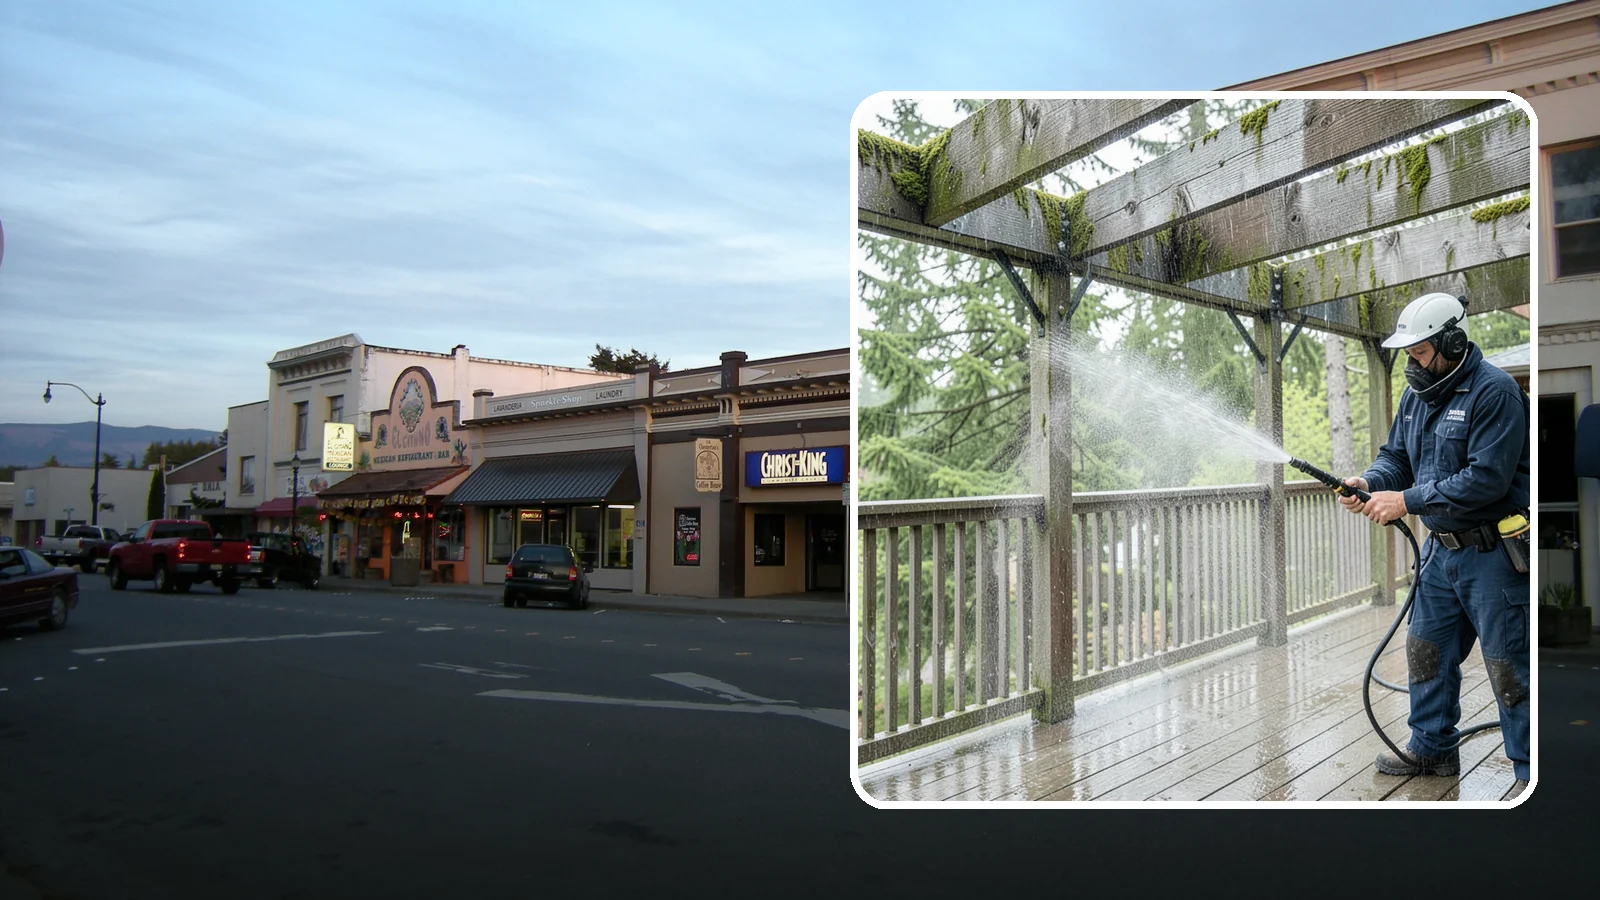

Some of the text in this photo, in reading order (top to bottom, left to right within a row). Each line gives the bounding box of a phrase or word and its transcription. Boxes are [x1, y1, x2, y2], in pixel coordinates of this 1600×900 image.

[494, 389, 623, 412] LAVANDERIA Sparkle Shop LAUNDRY
[373, 455, 396, 464] MEXICAN
[398, 451, 433, 462] RESTAURANT
[438, 450, 450, 459] BAR
[761, 450, 827, 477] CHRIST KING
